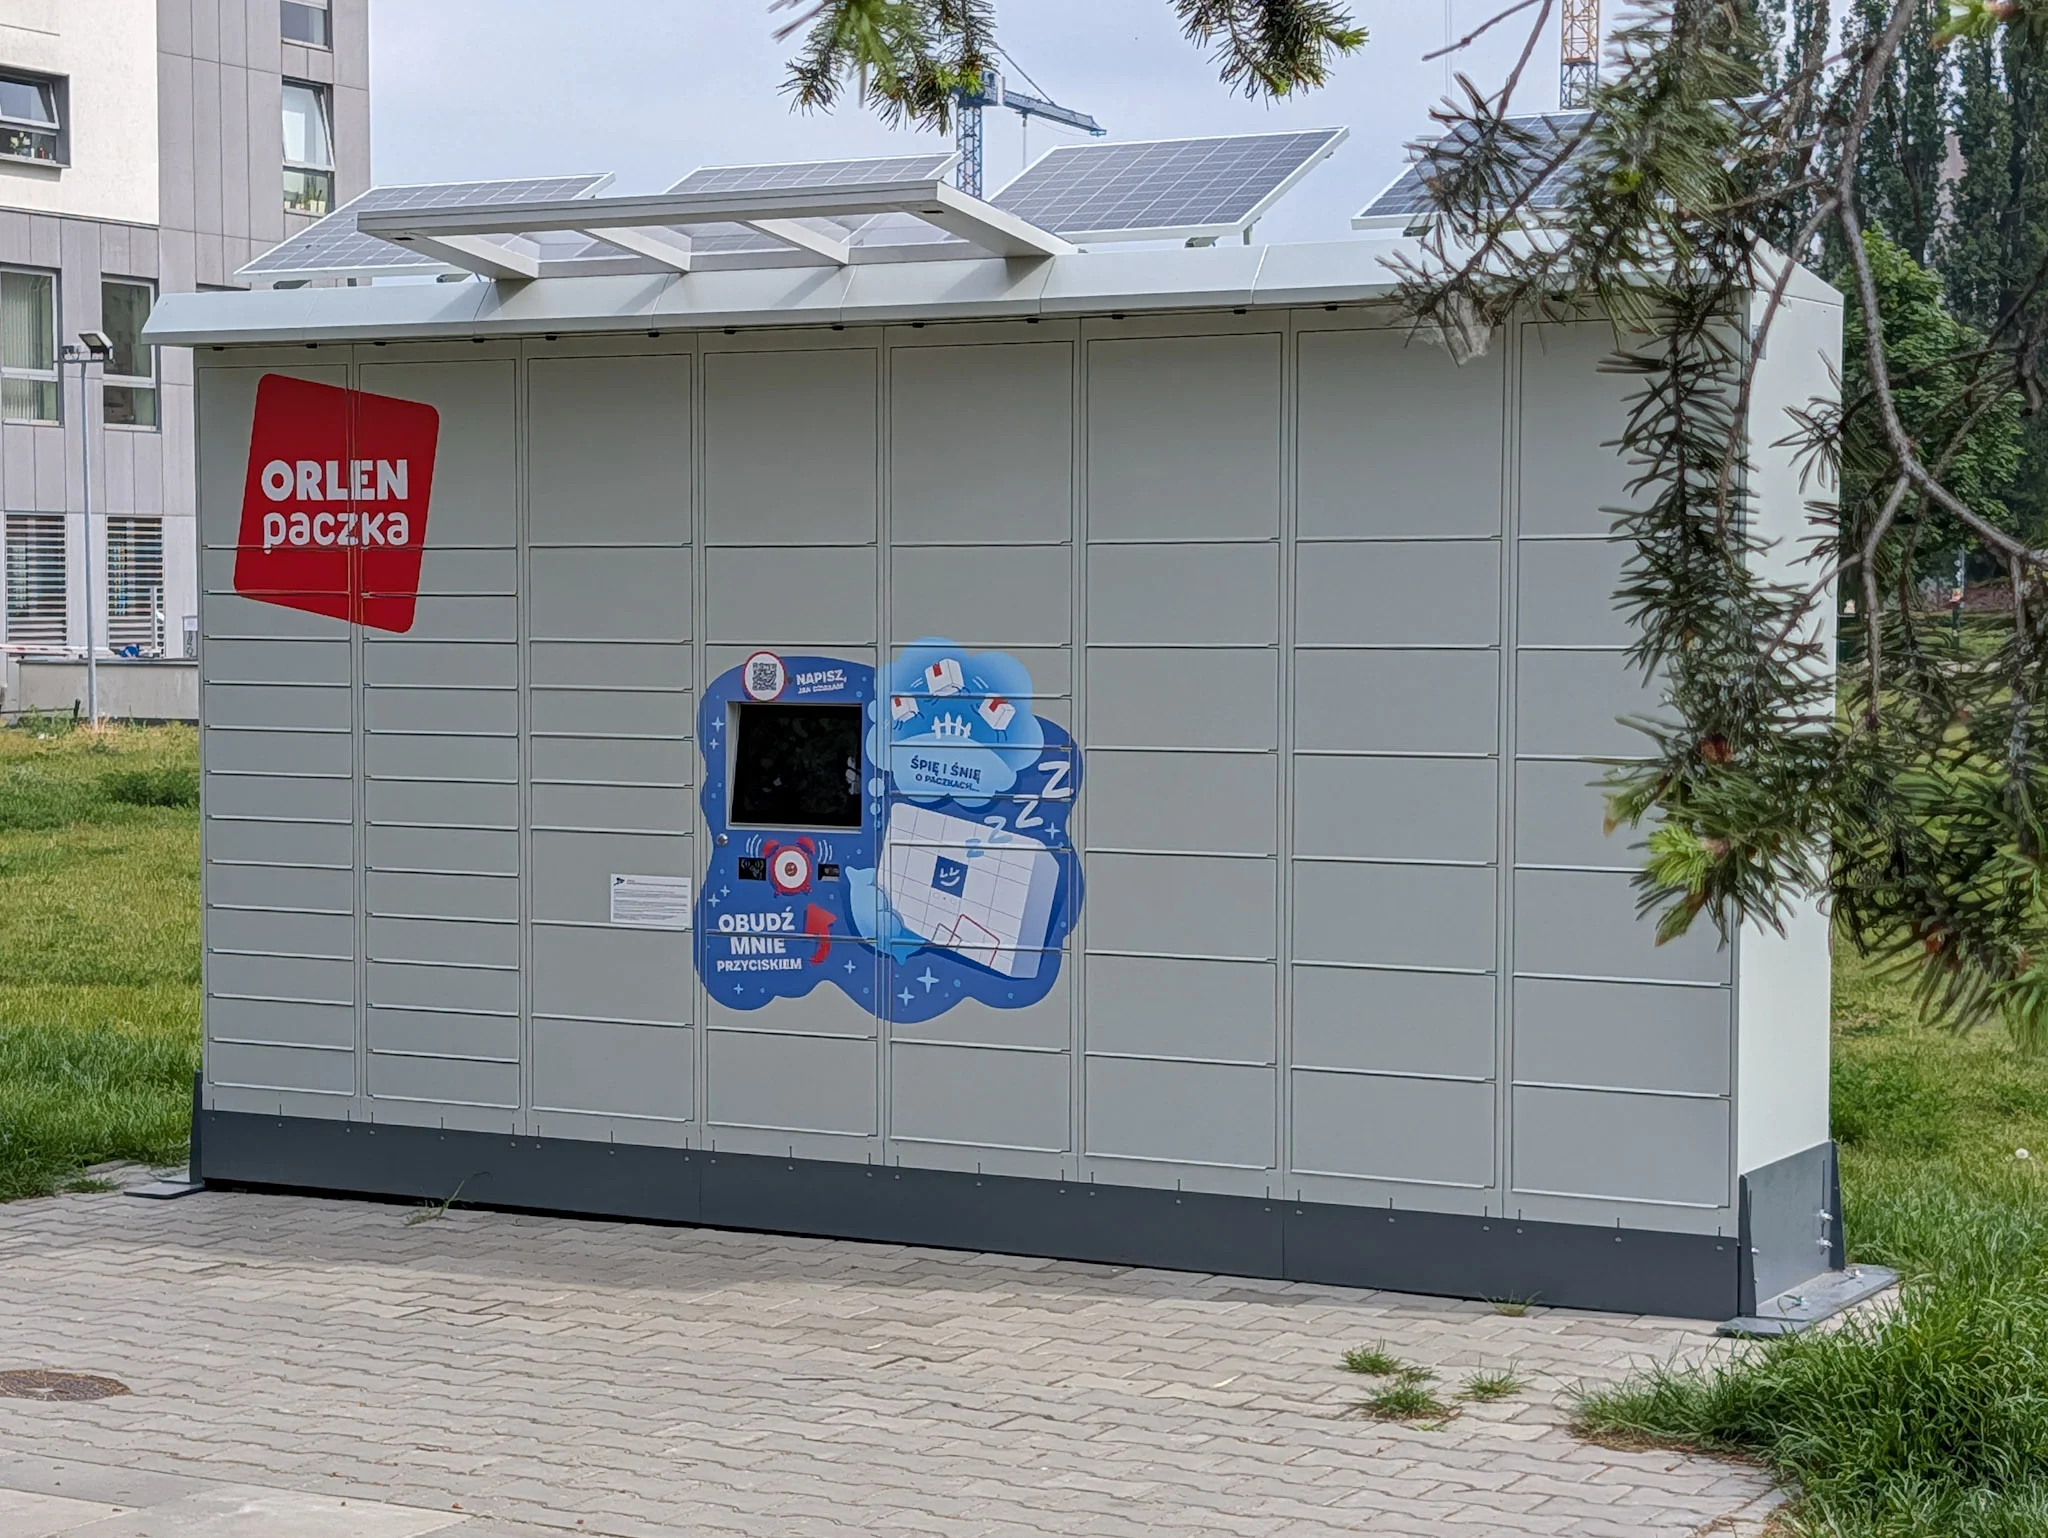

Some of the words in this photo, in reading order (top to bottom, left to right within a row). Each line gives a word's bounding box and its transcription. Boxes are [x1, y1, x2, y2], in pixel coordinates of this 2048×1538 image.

[261, 459, 408, 501] ORLEN
[263, 512, 409, 554] paczka
[910, 755, 940, 776] ŚPIĘ
[718, 906, 795, 933] OBUDŹ
[730, 936, 786, 955] MNIE
[716, 957, 802, 972] PRZYCISKIEM
